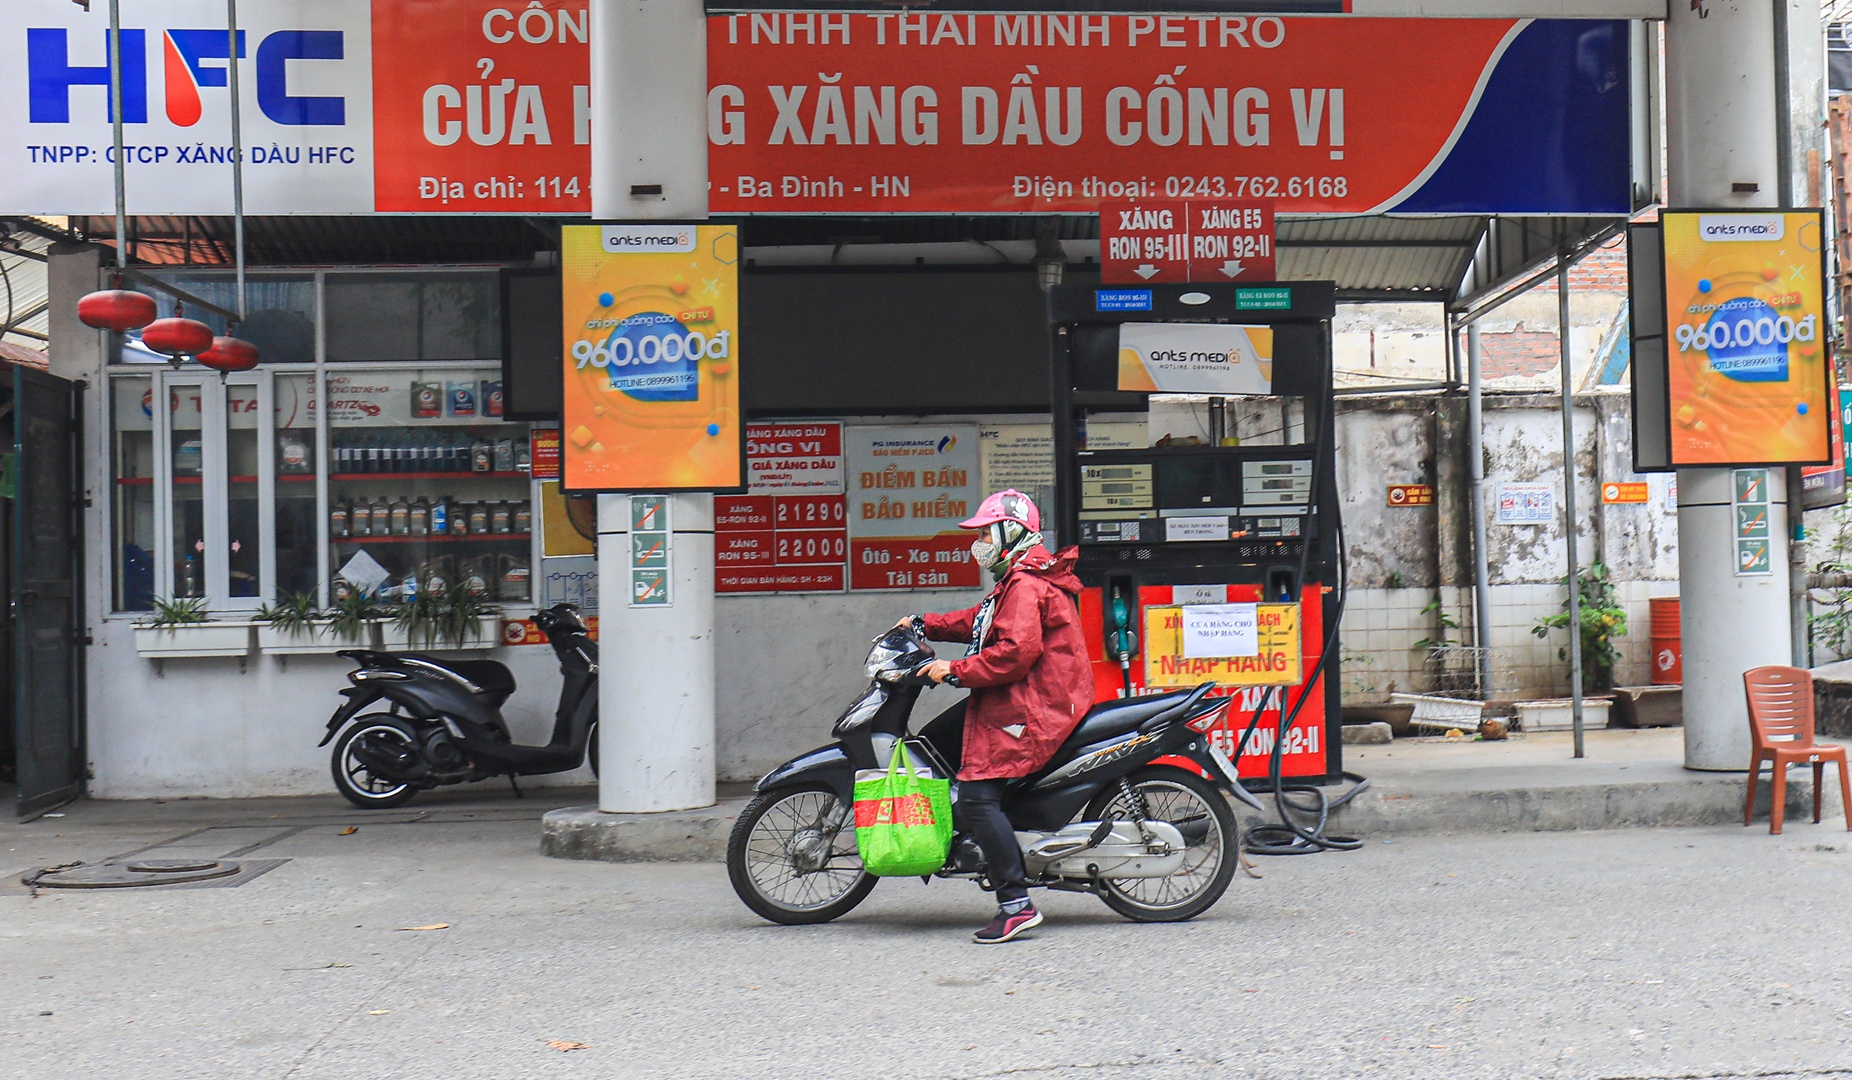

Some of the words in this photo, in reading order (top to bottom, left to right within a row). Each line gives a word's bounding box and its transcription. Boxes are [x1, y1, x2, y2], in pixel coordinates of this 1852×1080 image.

[482, 1, 589, 44] CÔN
[726, 14, 850, 45] TNHH
[994, 15, 1110, 47] MINH
[1128, 16, 1286, 49] PETRO
[27, 28, 345, 126] HFC
[422, 57, 552, 146] CỬA
[768, 72, 939, 146] XĂNG
[961, 65, 1083, 147] DẦU
[1105, 65, 1270, 147] CỐNG
[1289, 88, 1345, 160] VỊ
[27, 146, 97, 164] TNPP:
[106, 146, 169, 164] CTCP
[176, 142, 243, 164] XĂNG
[252, 142, 300, 164] DẦU
[309, 147, 355, 164] HFC
[418, 176, 465, 204] Địa
[473, 175, 524, 199] chỉ:
[535, 177, 580, 198] 114
[738, 176, 773, 198] Ba
[781, 175, 844, 197] Đình
[871, 176, 910, 197] HN
[1013, 175, 1072, 202] Điện
[1081, 175, 1156, 203] thoại:
[1165, 176, 1348, 198] 0243.762.6168
[1119, 206, 1174, 230] XĂNG
[1201, 206, 1241, 229] XĂNG
[1244, 208, 1262, 229] E5
[1707, 224, 1735, 235] ants
[610, 235, 642, 246] ants
[1109, 236, 1141, 260] RON
[1144, 234, 1189, 261] 95-III
[1194, 235, 1228, 259] RON
[1232, 234, 1270, 259] 92-II
[1675, 313, 1817, 352] 960.000đ
[572, 329, 730, 370] 960.000đ
[1151, 349, 1187, 362] ants
[307, 400, 359, 410] QARTZ
[774, 428, 802, 438] XĂNG
[747, 440, 793, 455] ỐNG
[799, 442, 821, 455] VỊ
[912, 448, 935, 456] PJICO
[752, 460, 772, 470] GIÁ
[775, 461, 808, 470] XĂNG
[811, 458, 836, 470] DẦU
[860, 463, 916, 489] ĐIỂM
[922, 465, 968, 488] BÁN
[729, 505, 754, 513] XĂNG
[778, 502, 843, 521] 21290
[862, 496, 906, 519] BẢO
[912, 493, 967, 519] HIỂM
[718, 551, 740, 560] RON
[729, 539, 759, 548] XĂNG
[779, 538, 844, 557] 22000
[862, 548, 890, 565] Ôtô
[908, 548, 930, 564] Xe
[936, 547, 971, 564] máy
[817, 575, 833, 583] 23H
[886, 569, 913, 586] Tài
[918, 569, 949, 585] sản
[1190, 620, 1209, 628] CỬA
[1210, 619, 1233, 628] HÀNG
[1257, 611, 1281, 626] ÁCH
[1197, 630, 1220, 638] NHẬP
[1221, 629, 1244, 637] HÀNG
[1212, 730, 1235, 757] E5
[1280, 726, 1319, 755] 92-II
